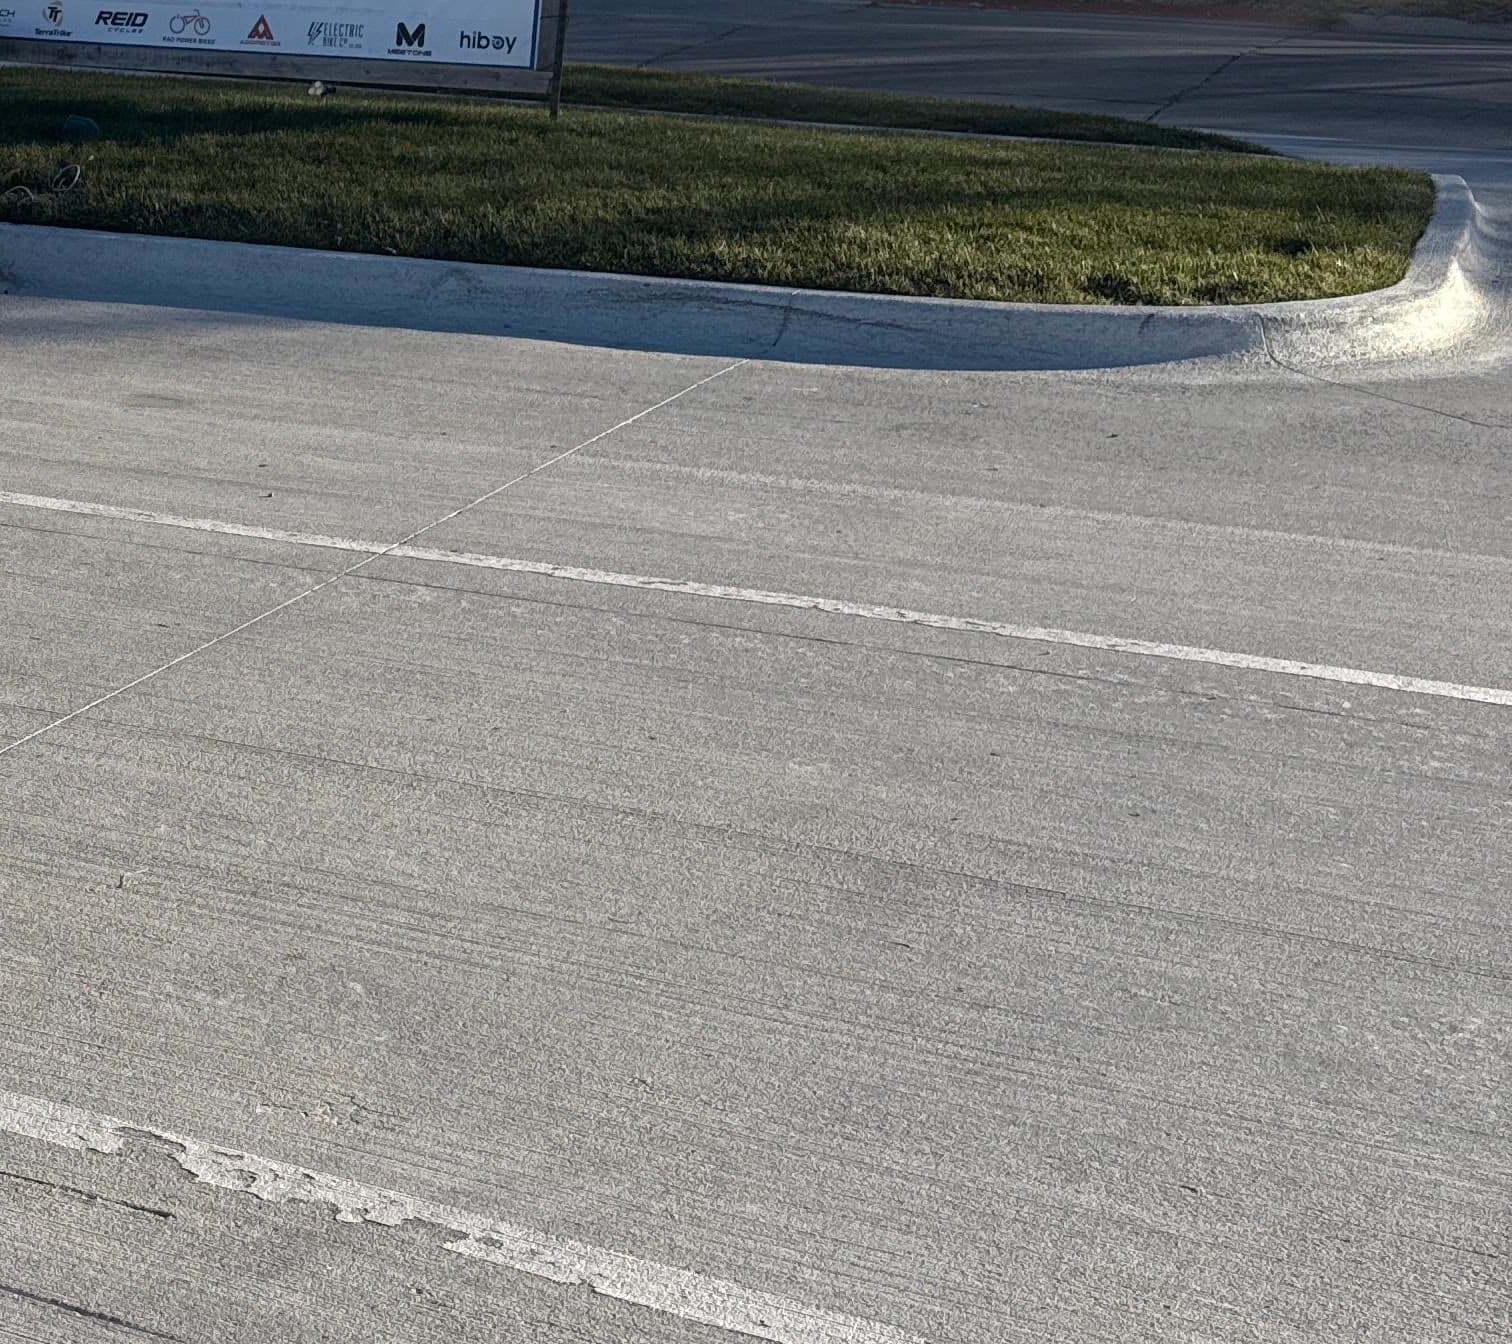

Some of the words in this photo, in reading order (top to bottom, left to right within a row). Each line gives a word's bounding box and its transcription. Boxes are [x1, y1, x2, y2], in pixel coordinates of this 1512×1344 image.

[95, 11, 148, 27] REID
[323, 22, 364, 38] ELECTRIC
[459, 30, 517, 54] hiboy
